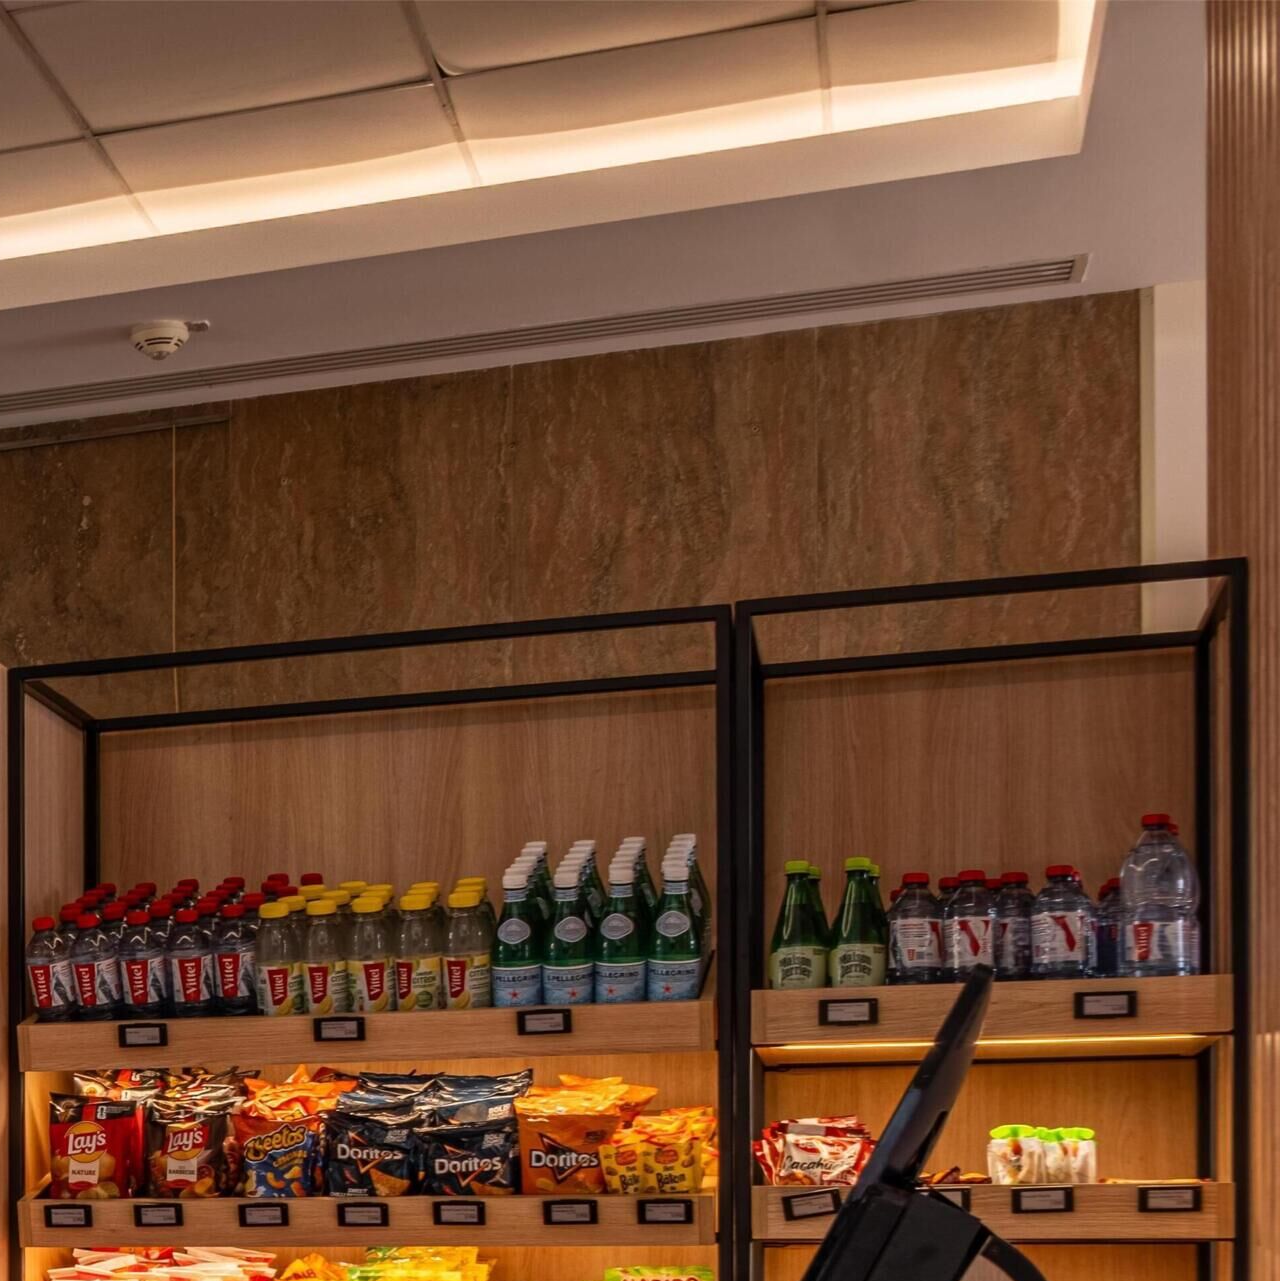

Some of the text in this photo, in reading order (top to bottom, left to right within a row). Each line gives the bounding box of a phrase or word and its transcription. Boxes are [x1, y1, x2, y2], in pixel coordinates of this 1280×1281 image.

[34, 969, 48, 1000] Vittel
[79, 967, 89, 1000] Vittel
[133, 965, 143, 998] Vittel
[185, 962, 197, 996] Vittel
[224, 953, 234, 990] Vittel
[370, 968, 380, 995] Vittel
[399, 967, 408, 995] Vittel
[451, 966, 461, 996] Vittel
[273, 974, 284, 1002] Vittel
[315, 972, 324, 1000] Vittel
[68, 1131, 107, 1155] Lay's
[168, 1128, 203, 1152] Lay's
[246, 1126, 307, 1161] Cheetos
[337, 1144, 403, 1160] Doritos
[435, 1156, 502, 1175] Doritos
[531, 1150, 599, 1168] Doritos
